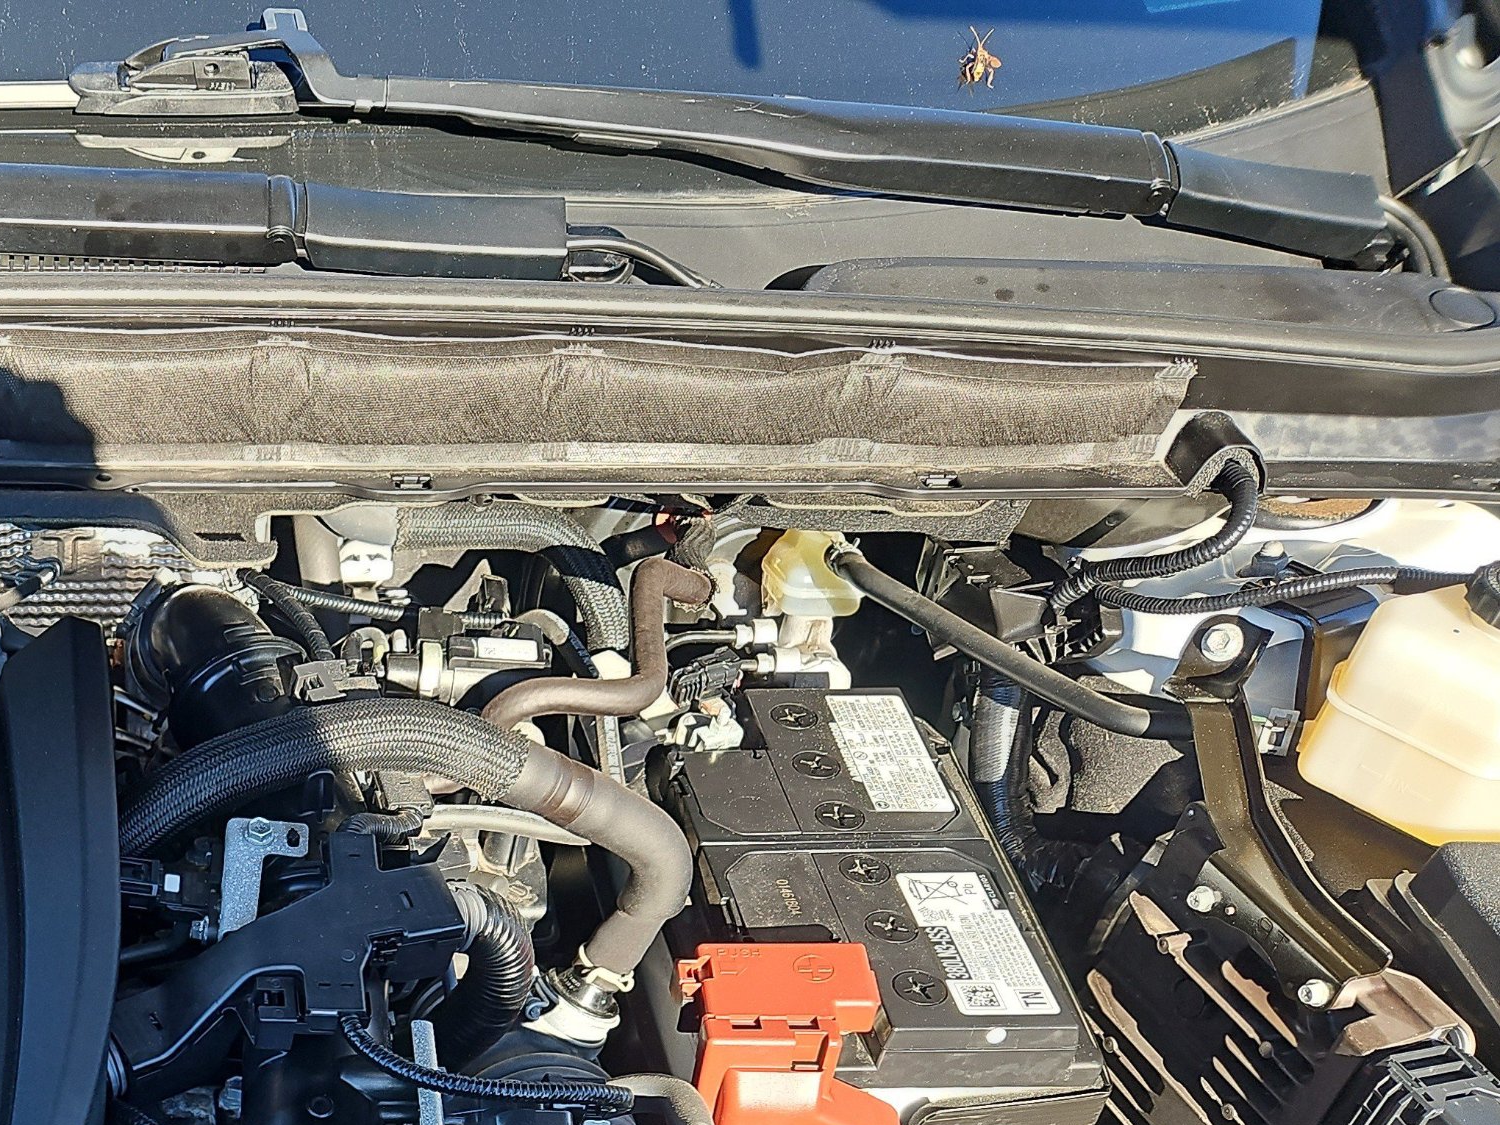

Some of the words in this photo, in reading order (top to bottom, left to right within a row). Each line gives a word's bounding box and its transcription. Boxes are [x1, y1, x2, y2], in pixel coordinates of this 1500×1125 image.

[963, 883, 977, 894] Pb
[925, 926, 970, 979] 380LN3-ISS
[1019, 991, 1047, 1007] TN
